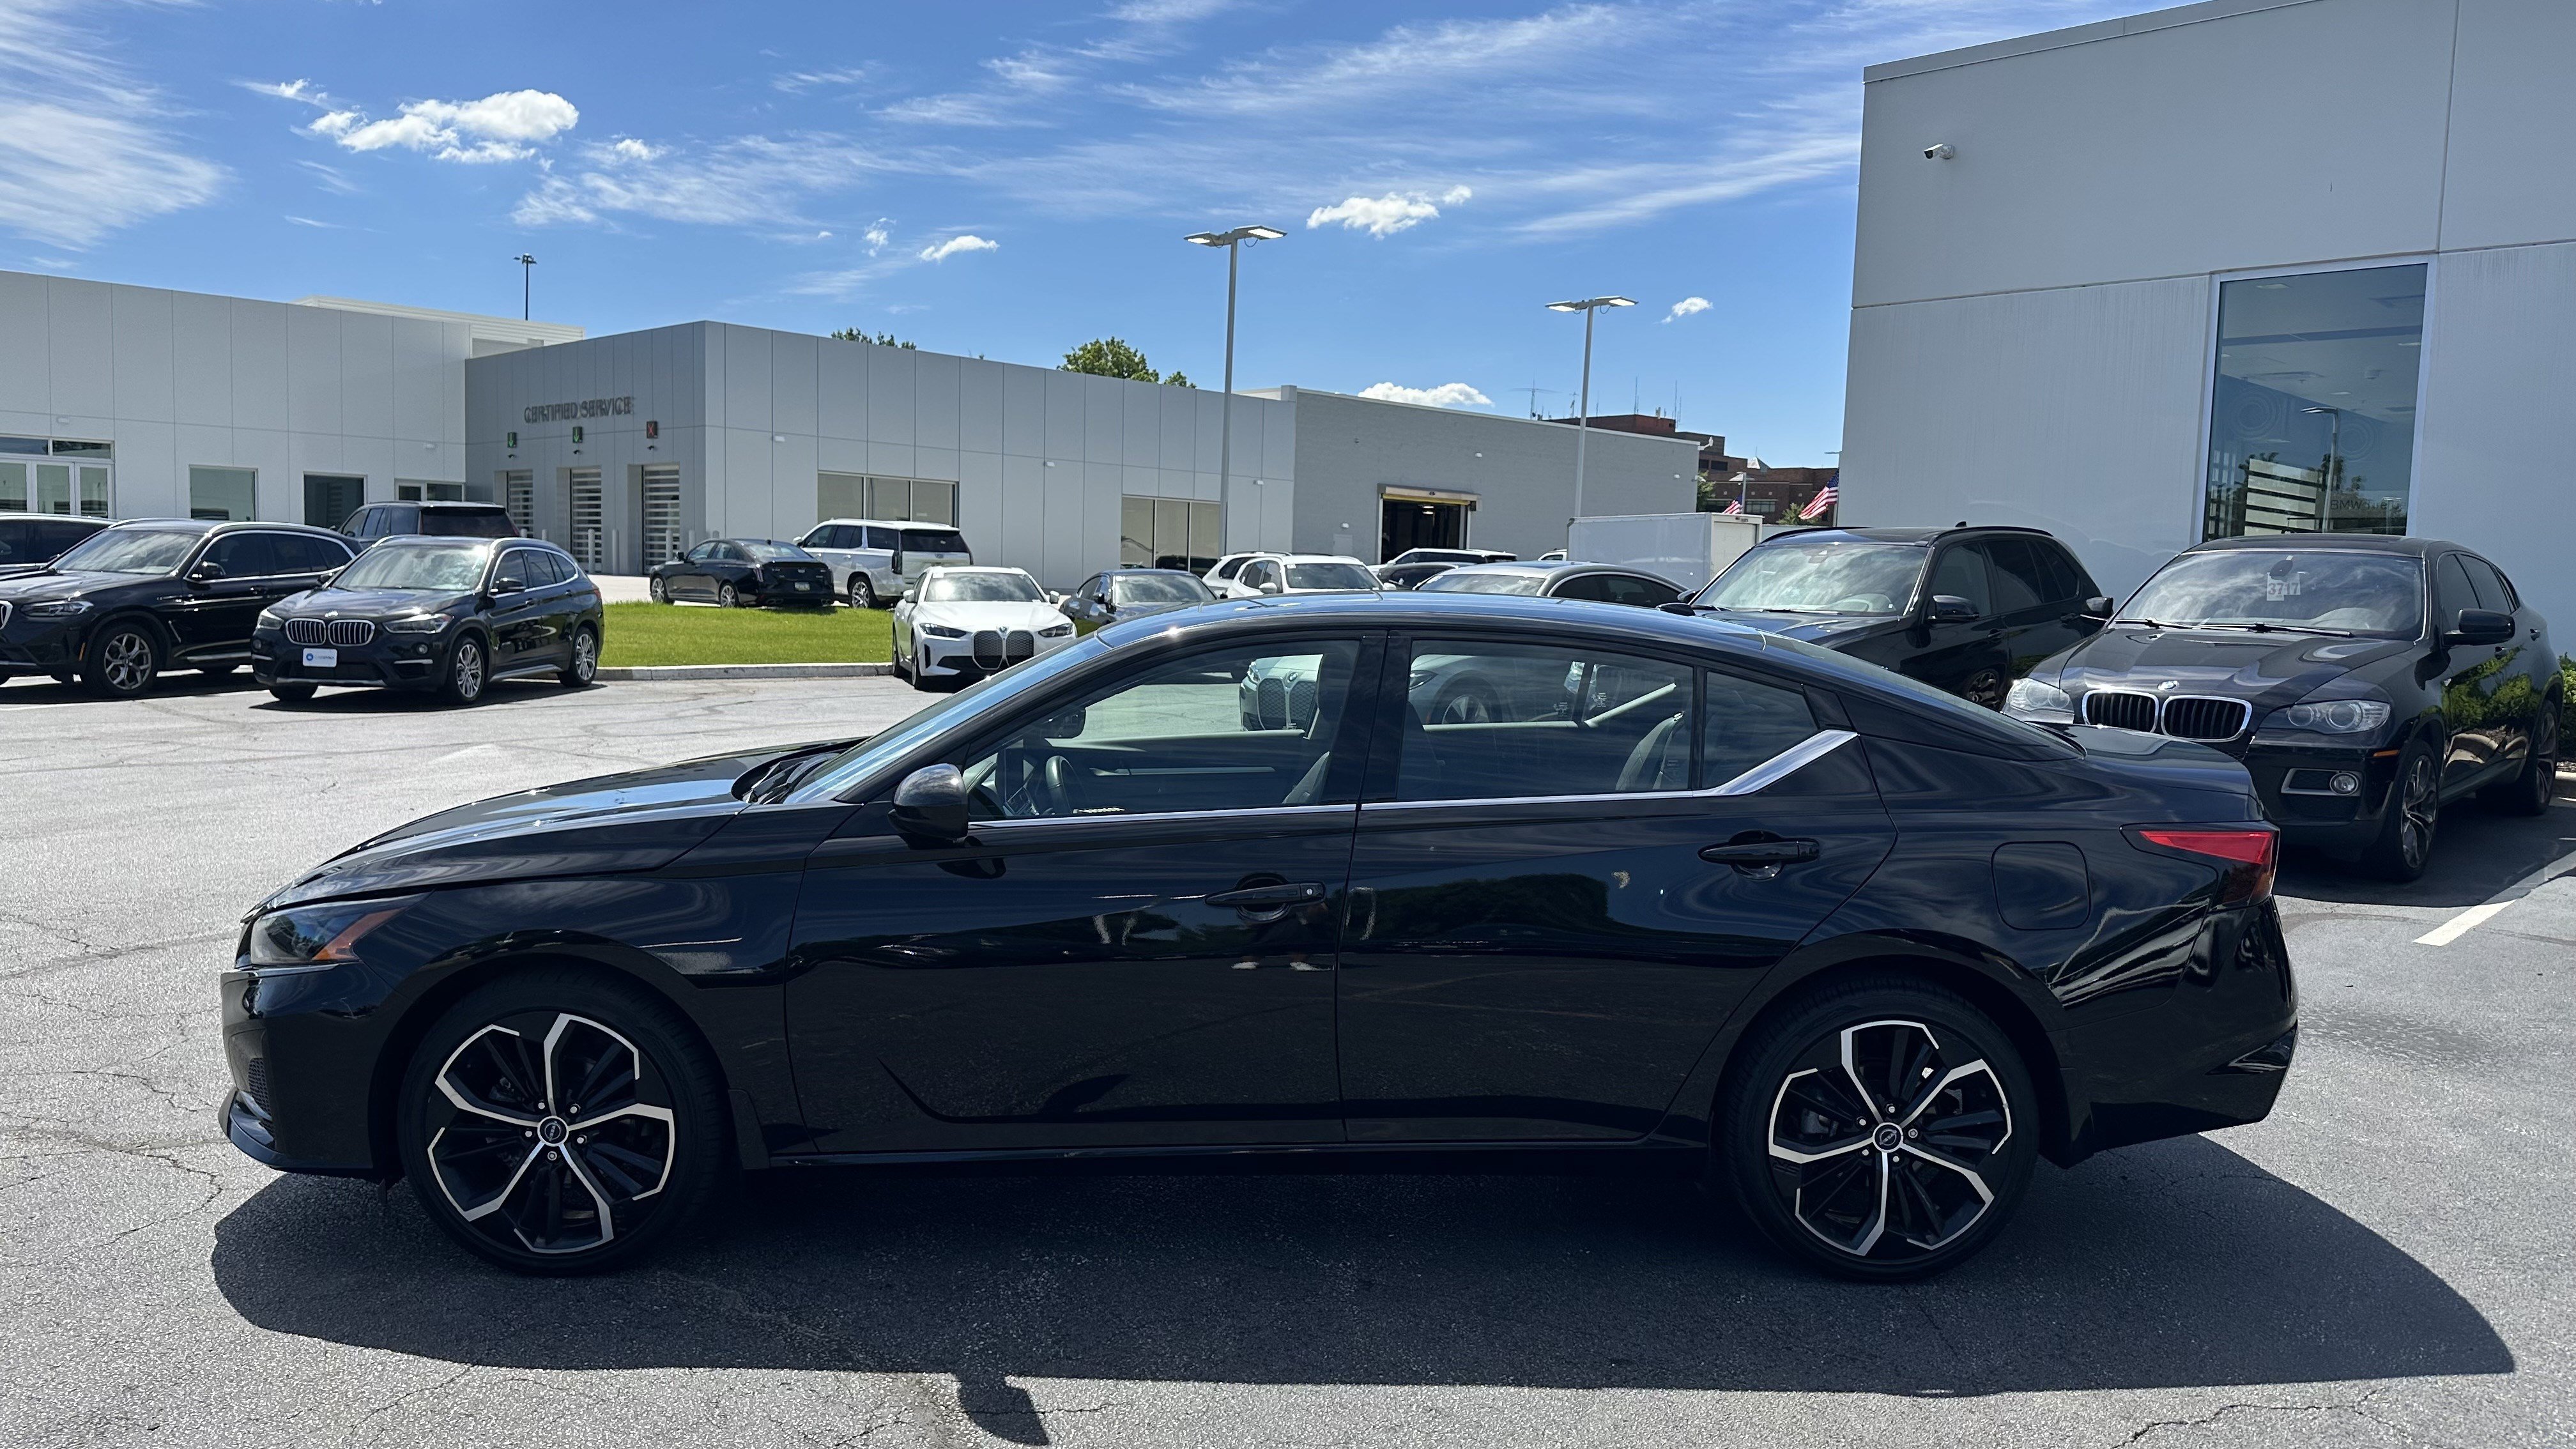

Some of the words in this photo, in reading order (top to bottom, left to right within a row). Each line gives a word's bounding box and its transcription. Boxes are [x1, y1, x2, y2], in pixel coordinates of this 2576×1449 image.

[524, 402, 578, 424] CERTIFIED
[581, 396, 631, 418] SERVICE
[2268, 582, 2299, 595] 3717
